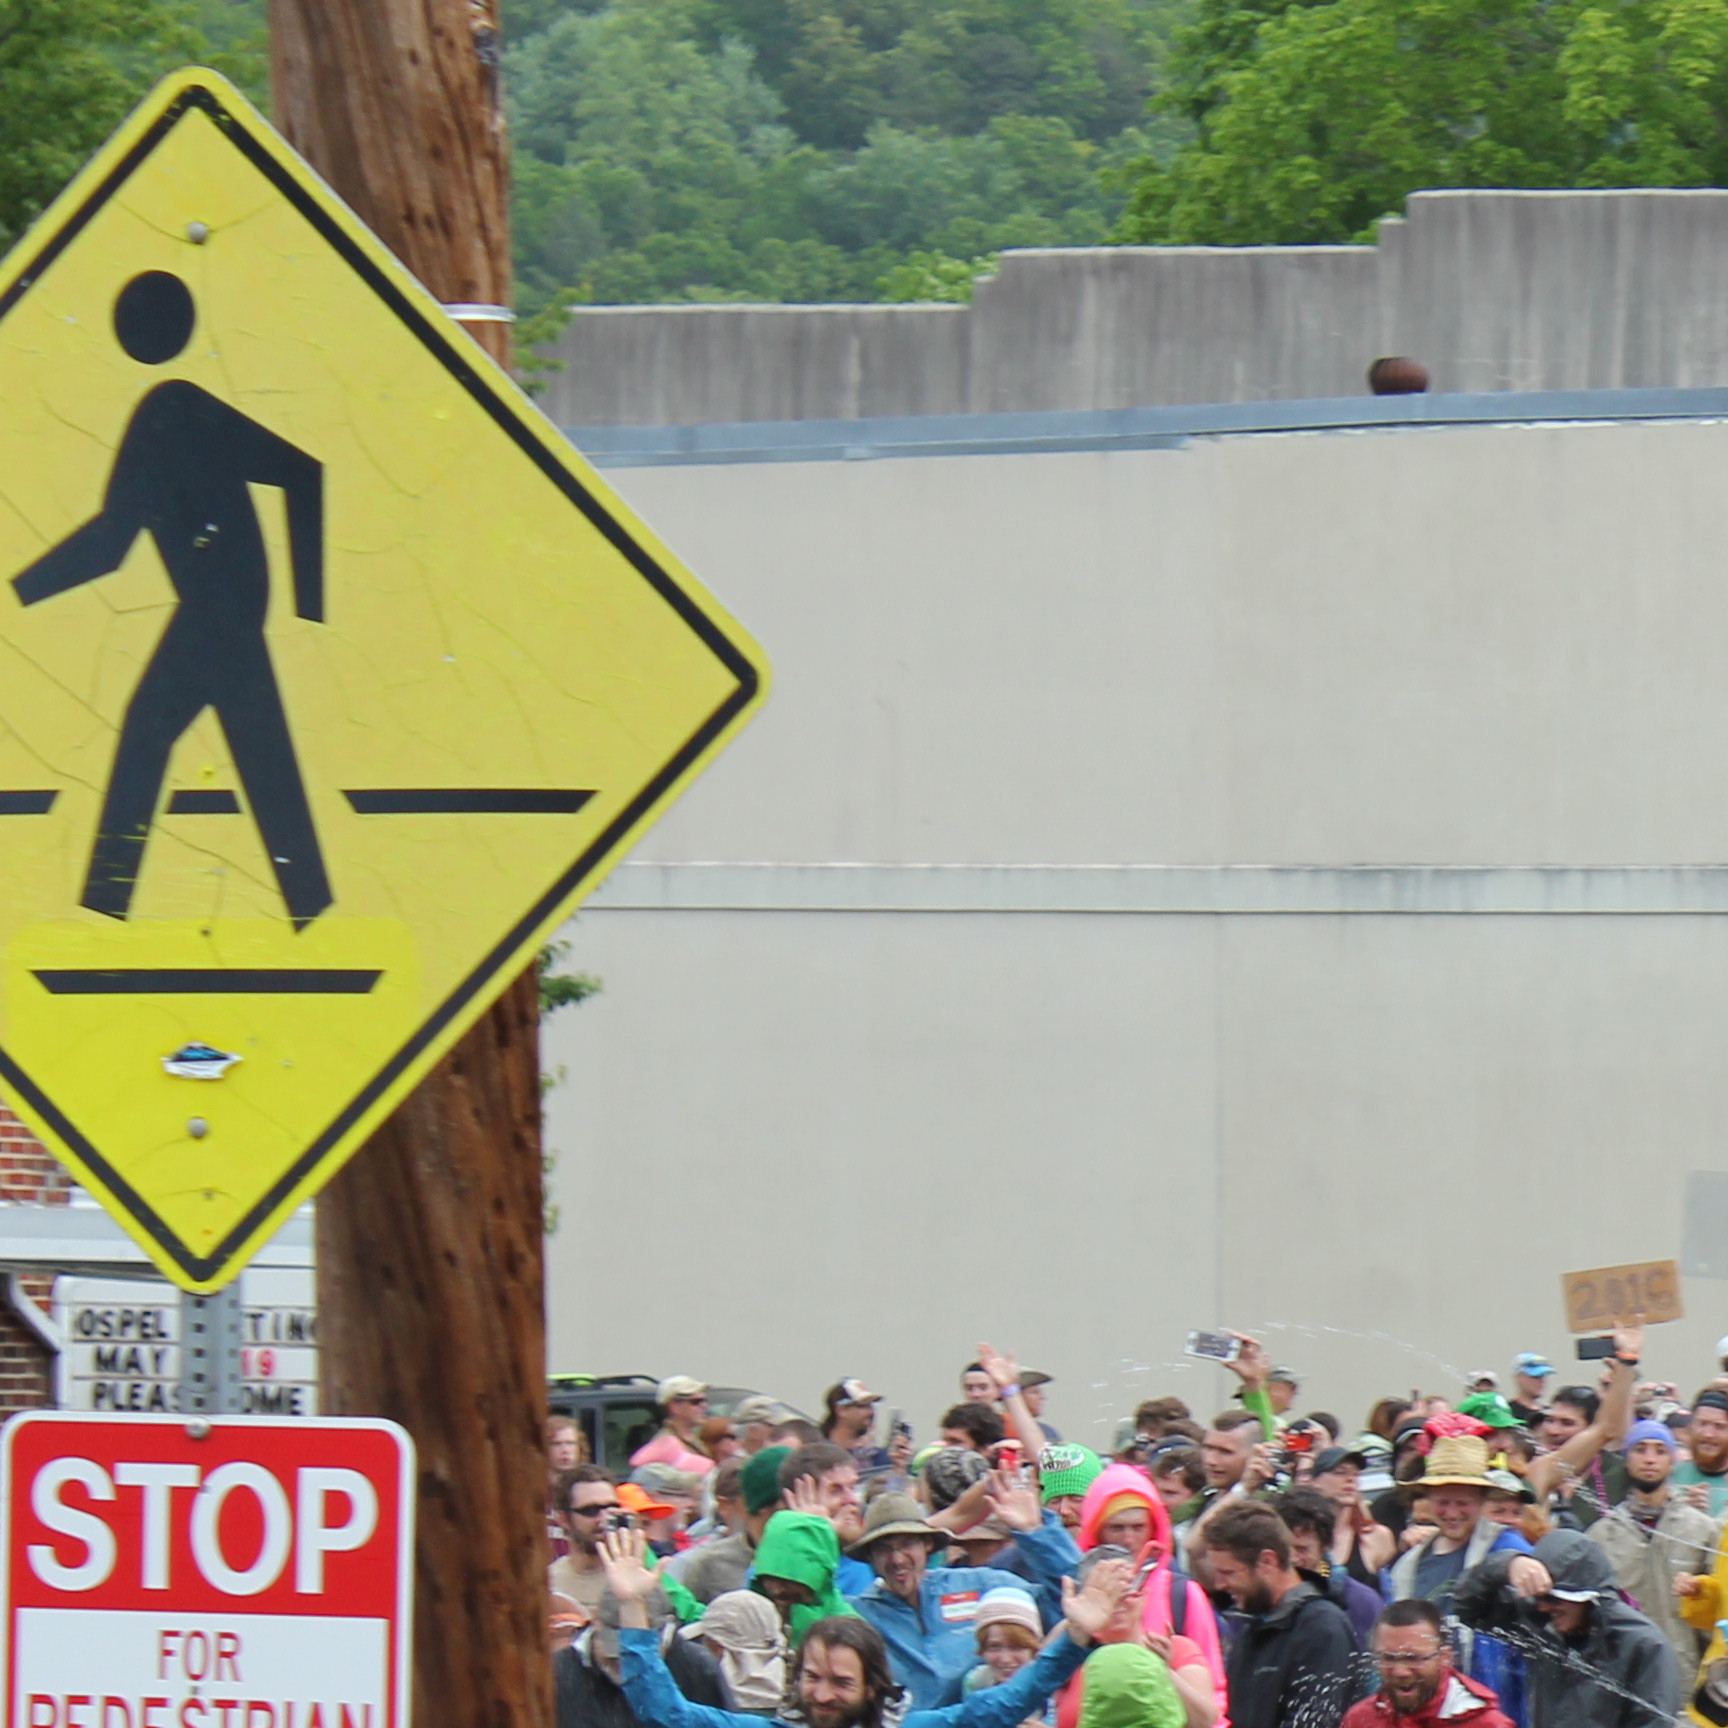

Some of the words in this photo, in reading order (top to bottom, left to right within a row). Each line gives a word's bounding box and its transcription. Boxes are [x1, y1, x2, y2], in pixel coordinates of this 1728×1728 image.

[1570, 1268, 1675, 1320] 2016
[94, 1345, 165, 1374] MAY
[26, 1457, 379, 1596] STOP
[158, 1629, 242, 1683] FOR
